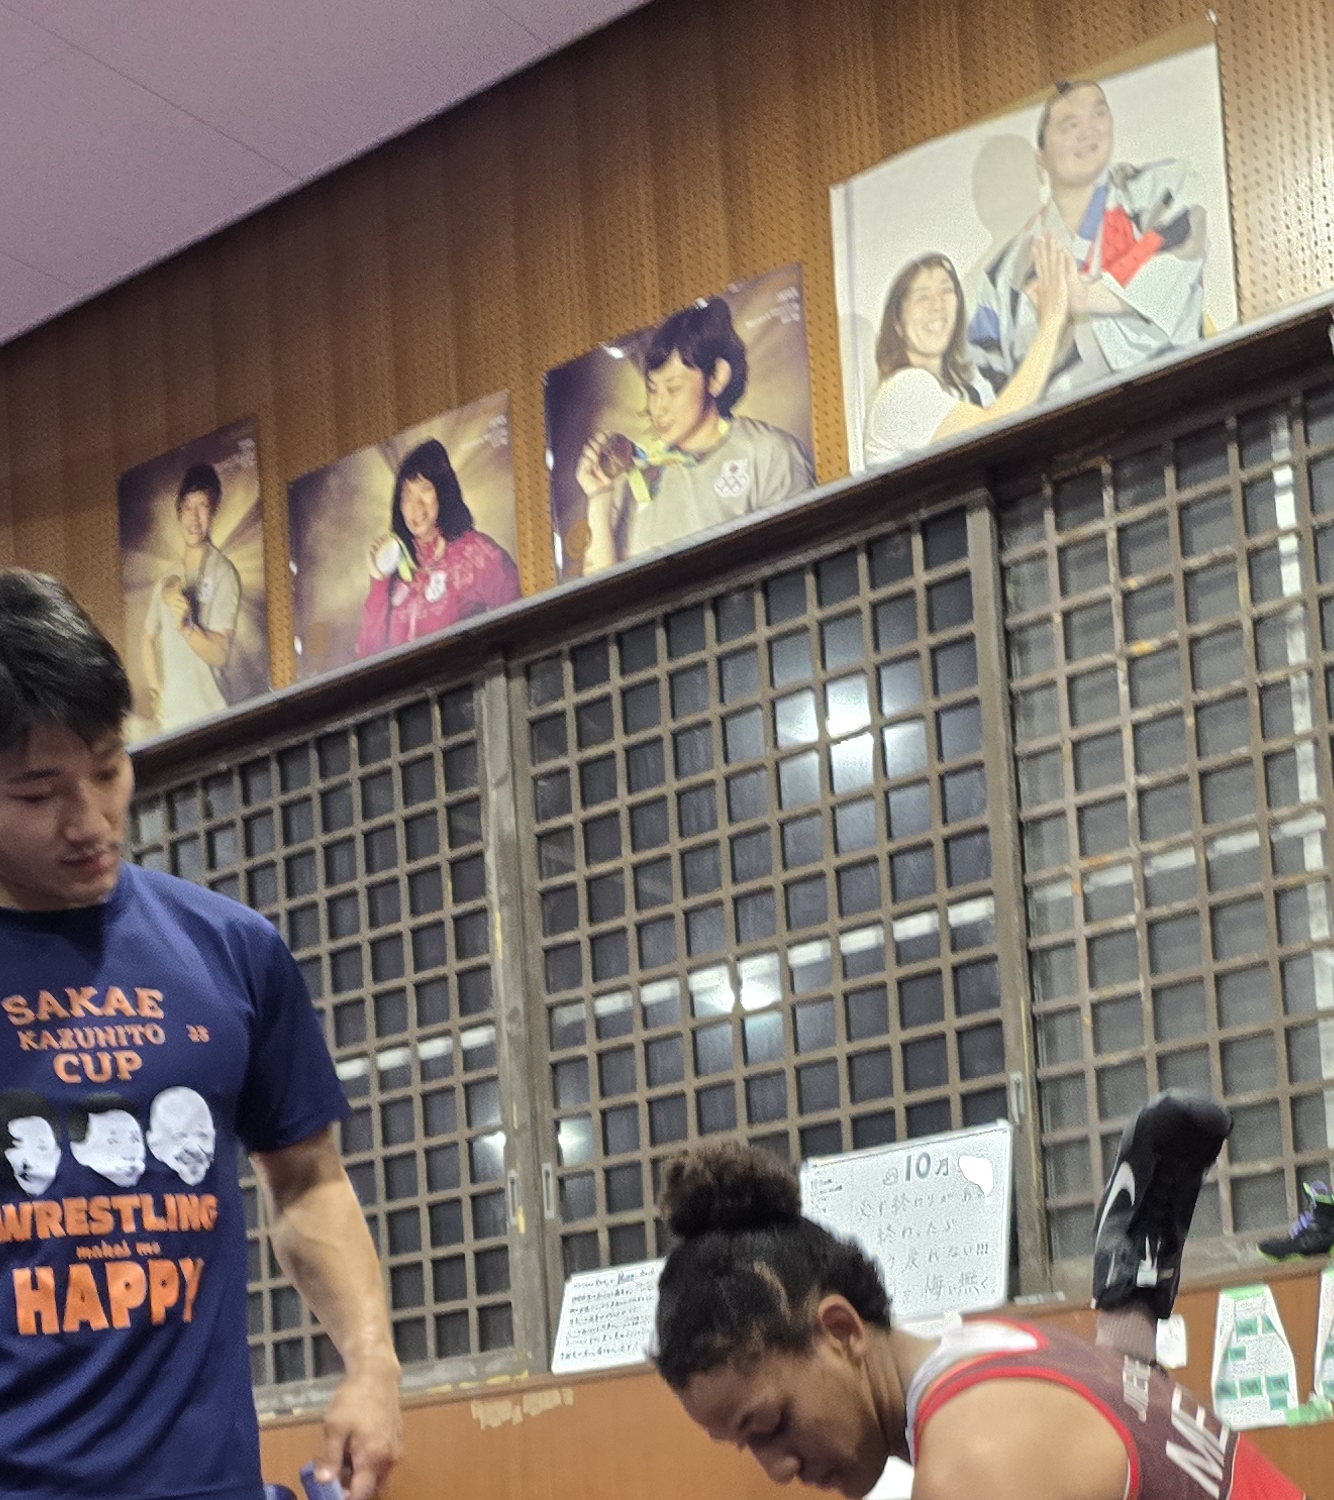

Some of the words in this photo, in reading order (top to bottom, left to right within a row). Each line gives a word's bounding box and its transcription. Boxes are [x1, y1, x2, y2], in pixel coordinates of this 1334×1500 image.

[1, 986, 165, 1026] SAKAE
[53, 1050, 144, 1084] CUP
[12, 1258, 205, 1336] HAPPY
